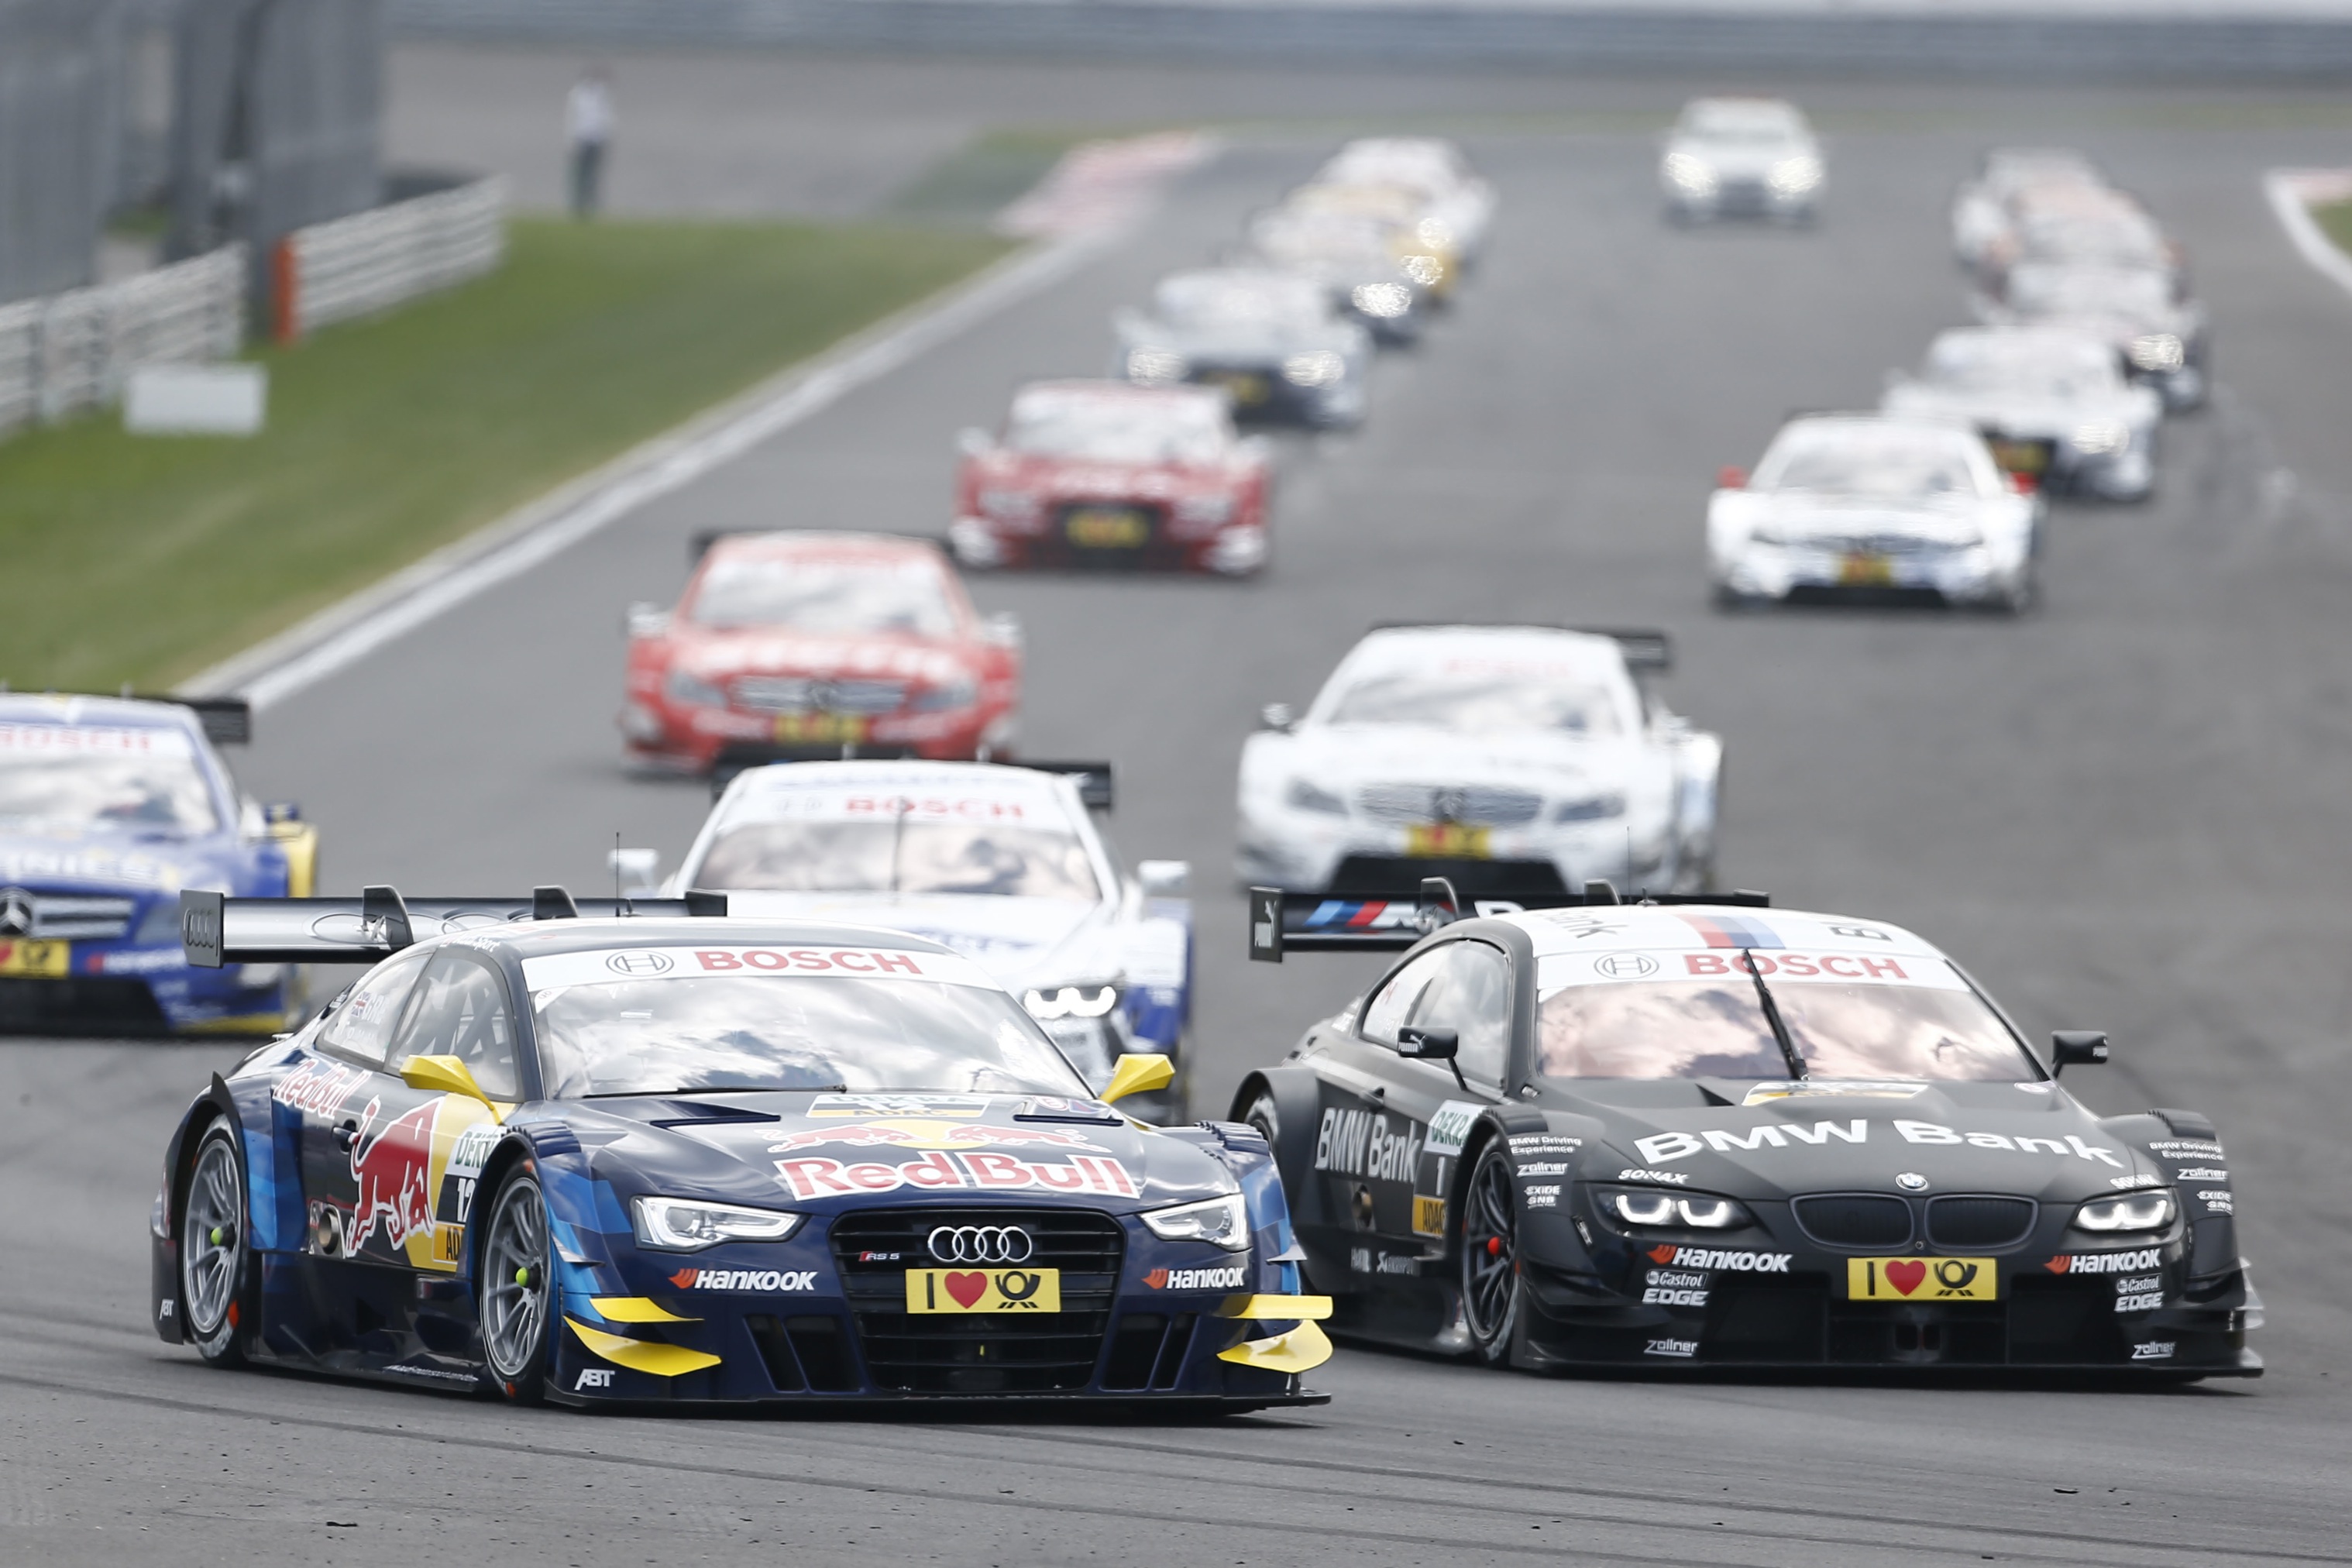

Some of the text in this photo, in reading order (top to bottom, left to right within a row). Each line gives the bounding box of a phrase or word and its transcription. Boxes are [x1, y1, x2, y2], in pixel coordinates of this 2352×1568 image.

[693, 950, 923, 975] BOSCH
[1683, 954, 1909, 979] BOSCH
[1315, 1108, 1421, 1184] BMW Bank
[1508, 1136, 1583, 1147] BMW Driving
[1511, 1146, 1575, 1156] Experience
[1633, 1119, 2125, 1168] BMW Bank
[2149, 1141, 2222, 1153] BMW Driving
[2161, 1150, 2224, 1161] Experience
[778, 1150, 1140, 1200] Red Bull
[1659, 1271, 1704, 1288] Castrol
[2128, 1275, 2160, 1292] Castrol
[1642, 1288, 1709, 1307] EDGE
[2113, 1291, 2165, 1313] EDGE
[574, 1367, 616, 1391] ABT
